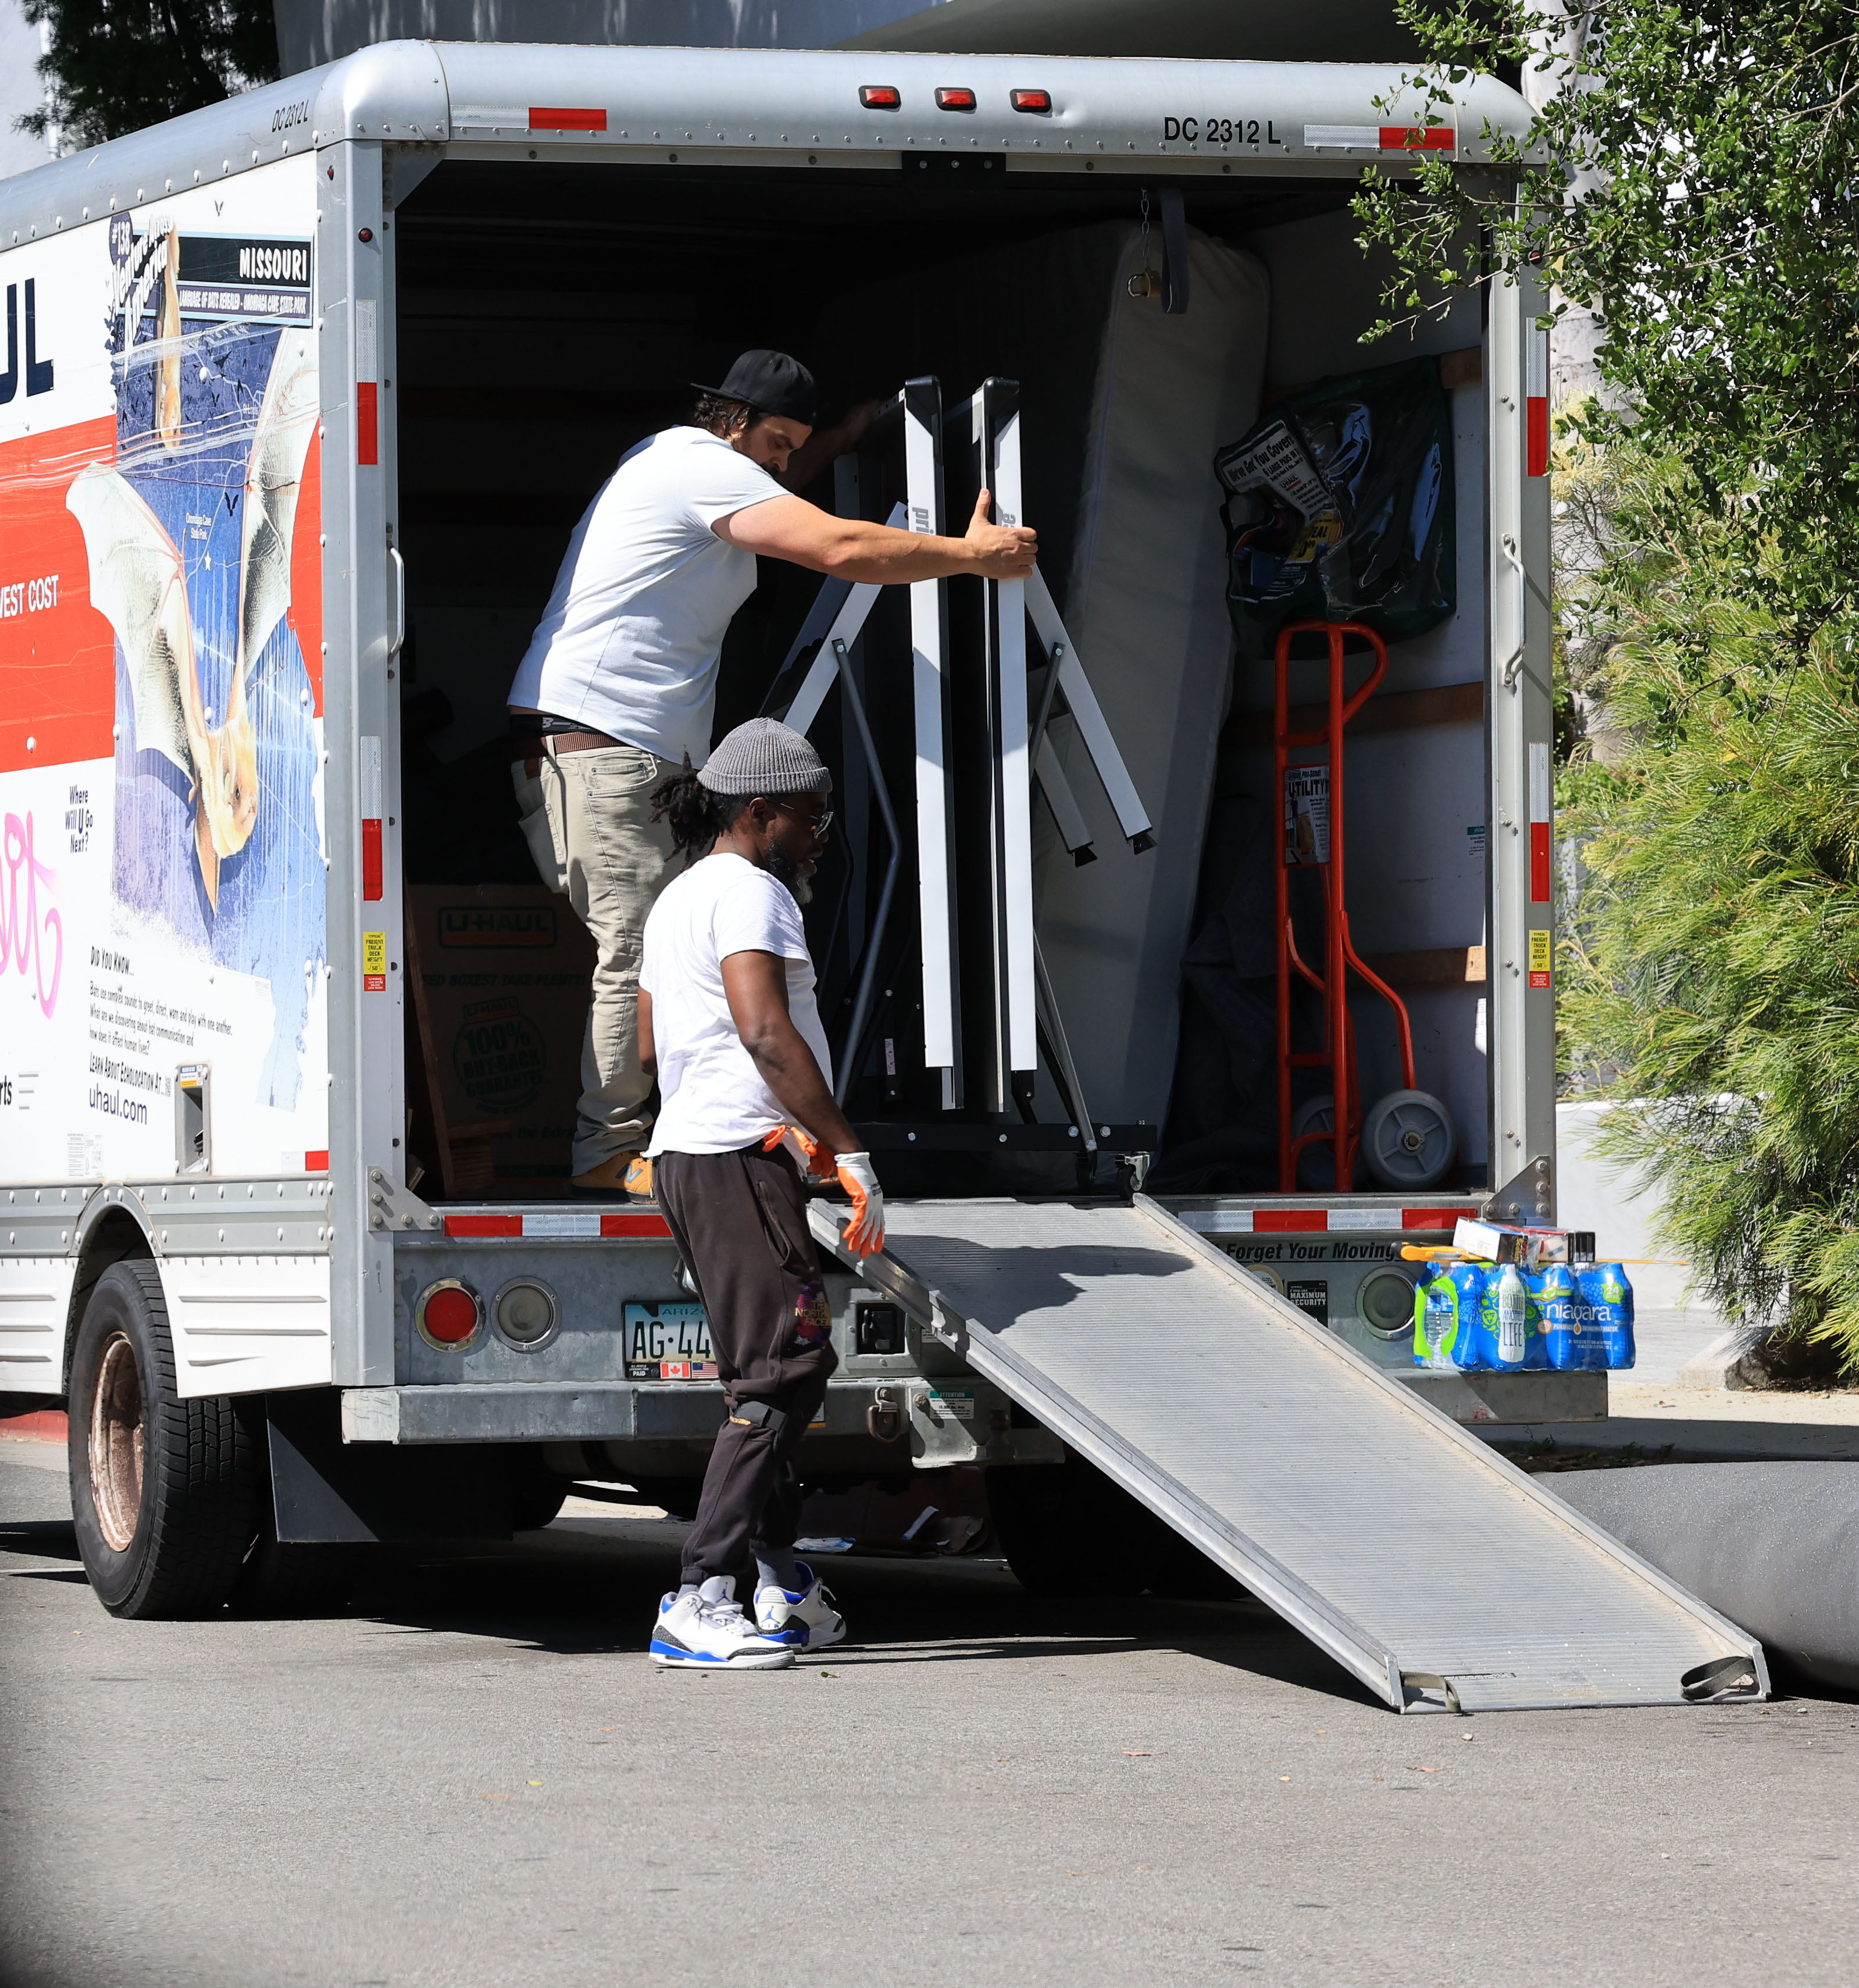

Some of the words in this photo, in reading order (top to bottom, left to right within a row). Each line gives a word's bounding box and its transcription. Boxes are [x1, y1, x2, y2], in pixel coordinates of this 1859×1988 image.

[272, 107, 286, 133] DC
[285, 101, 304, 129] 2312
[304, 99, 309, 122] L
[1164, 117, 1198, 141] DC
[1207, 119, 1259, 143] 2312
[1268, 120, 1281, 144] L
[112, 221, 131, 255] #138
[240, 247, 307, 281] MISSOURI
[179, 290, 201, 308] LANGUAGE
[202, 291, 208, 308] OF
[208, 292, 219, 309] BATS
[219, 293, 240, 311] REVEALED
[244, 294, 267, 312] ONONDAGA
[268, 295, 279, 312] CAVE
[280, 295, 294, 314] STATE
[294, 296, 306, 315] PARK
[1254, 452, 1270, 467] You
[1267, 460, 1282, 475] LARGE
[1280, 453, 1292, 469] PADS
[202, 514, 212, 526] Cave
[191, 528, 199, 540] State
[28, 574, 59, 612] COST
[70, 785, 88, 805] Where
[65, 809, 77, 830] Will
[79, 808, 84, 834] U
[85, 809, 93, 828] Go
[446, 913, 550, 933] U-HAUL
[449, 974, 497, 987] BOXES?
[502, 974, 532, 986] TAKE
[536, 974, 587, 986] PLENTY!
[90, 980, 99, 997] Bats
[108, 989, 123, 1006] complex
[124, 993, 137, 1009] sounds
[138, 996, 142, 1010] to
[188, 1010, 197, 1028] play
[198, 1012, 206, 1028] with
[90, 1003, 101, 1019] What
[109, 1013, 114, 1024] we
[115, 1010, 136, 1034] discovering
[137, 1016, 148, 1033] about
[156, 1026, 185, 1044] communication
[90, 1024, 98, 1040] how
[98, 1026, 107, 1043] does
[108, 1030, 111, 1044] it
[112, 1031, 123, 1048] affect
[124, 1034, 137, 1051] human
[138, 1038, 150, 1056] lives?
[465, 1019, 531, 1057] 100%
[90, 1052, 104, 1075] LEARN
[105, 1056, 120, 1081] ABOUT
[120, 1061, 154, 1092] ECHOLOCATION
[462, 1048, 541, 1079] BUY-BACK
[90, 1083, 147, 1125] uhaul.com
[1226, 1243, 1283, 1263] Forget
[1289, 1242, 1328, 1259] Your
[1332, 1242, 1396, 1262] Moving
[1514, 1238, 1522, 1262] Scotch
[1503, 1294, 1523, 1310] BOTTLE
[1607, 1286, 1620, 1295] 24
[795, 1307, 826, 1318] NORTH
[812, 1301, 826, 1310] THE
[1503, 1309, 1523, 1321] ANOTHER
[1547, 1302, 1612, 1321] niagara
[805, 1317, 827, 1327] FACE
[1503, 1321, 1522, 1346] LIFE
[1553, 1323, 1573, 1331] PURIFIED
